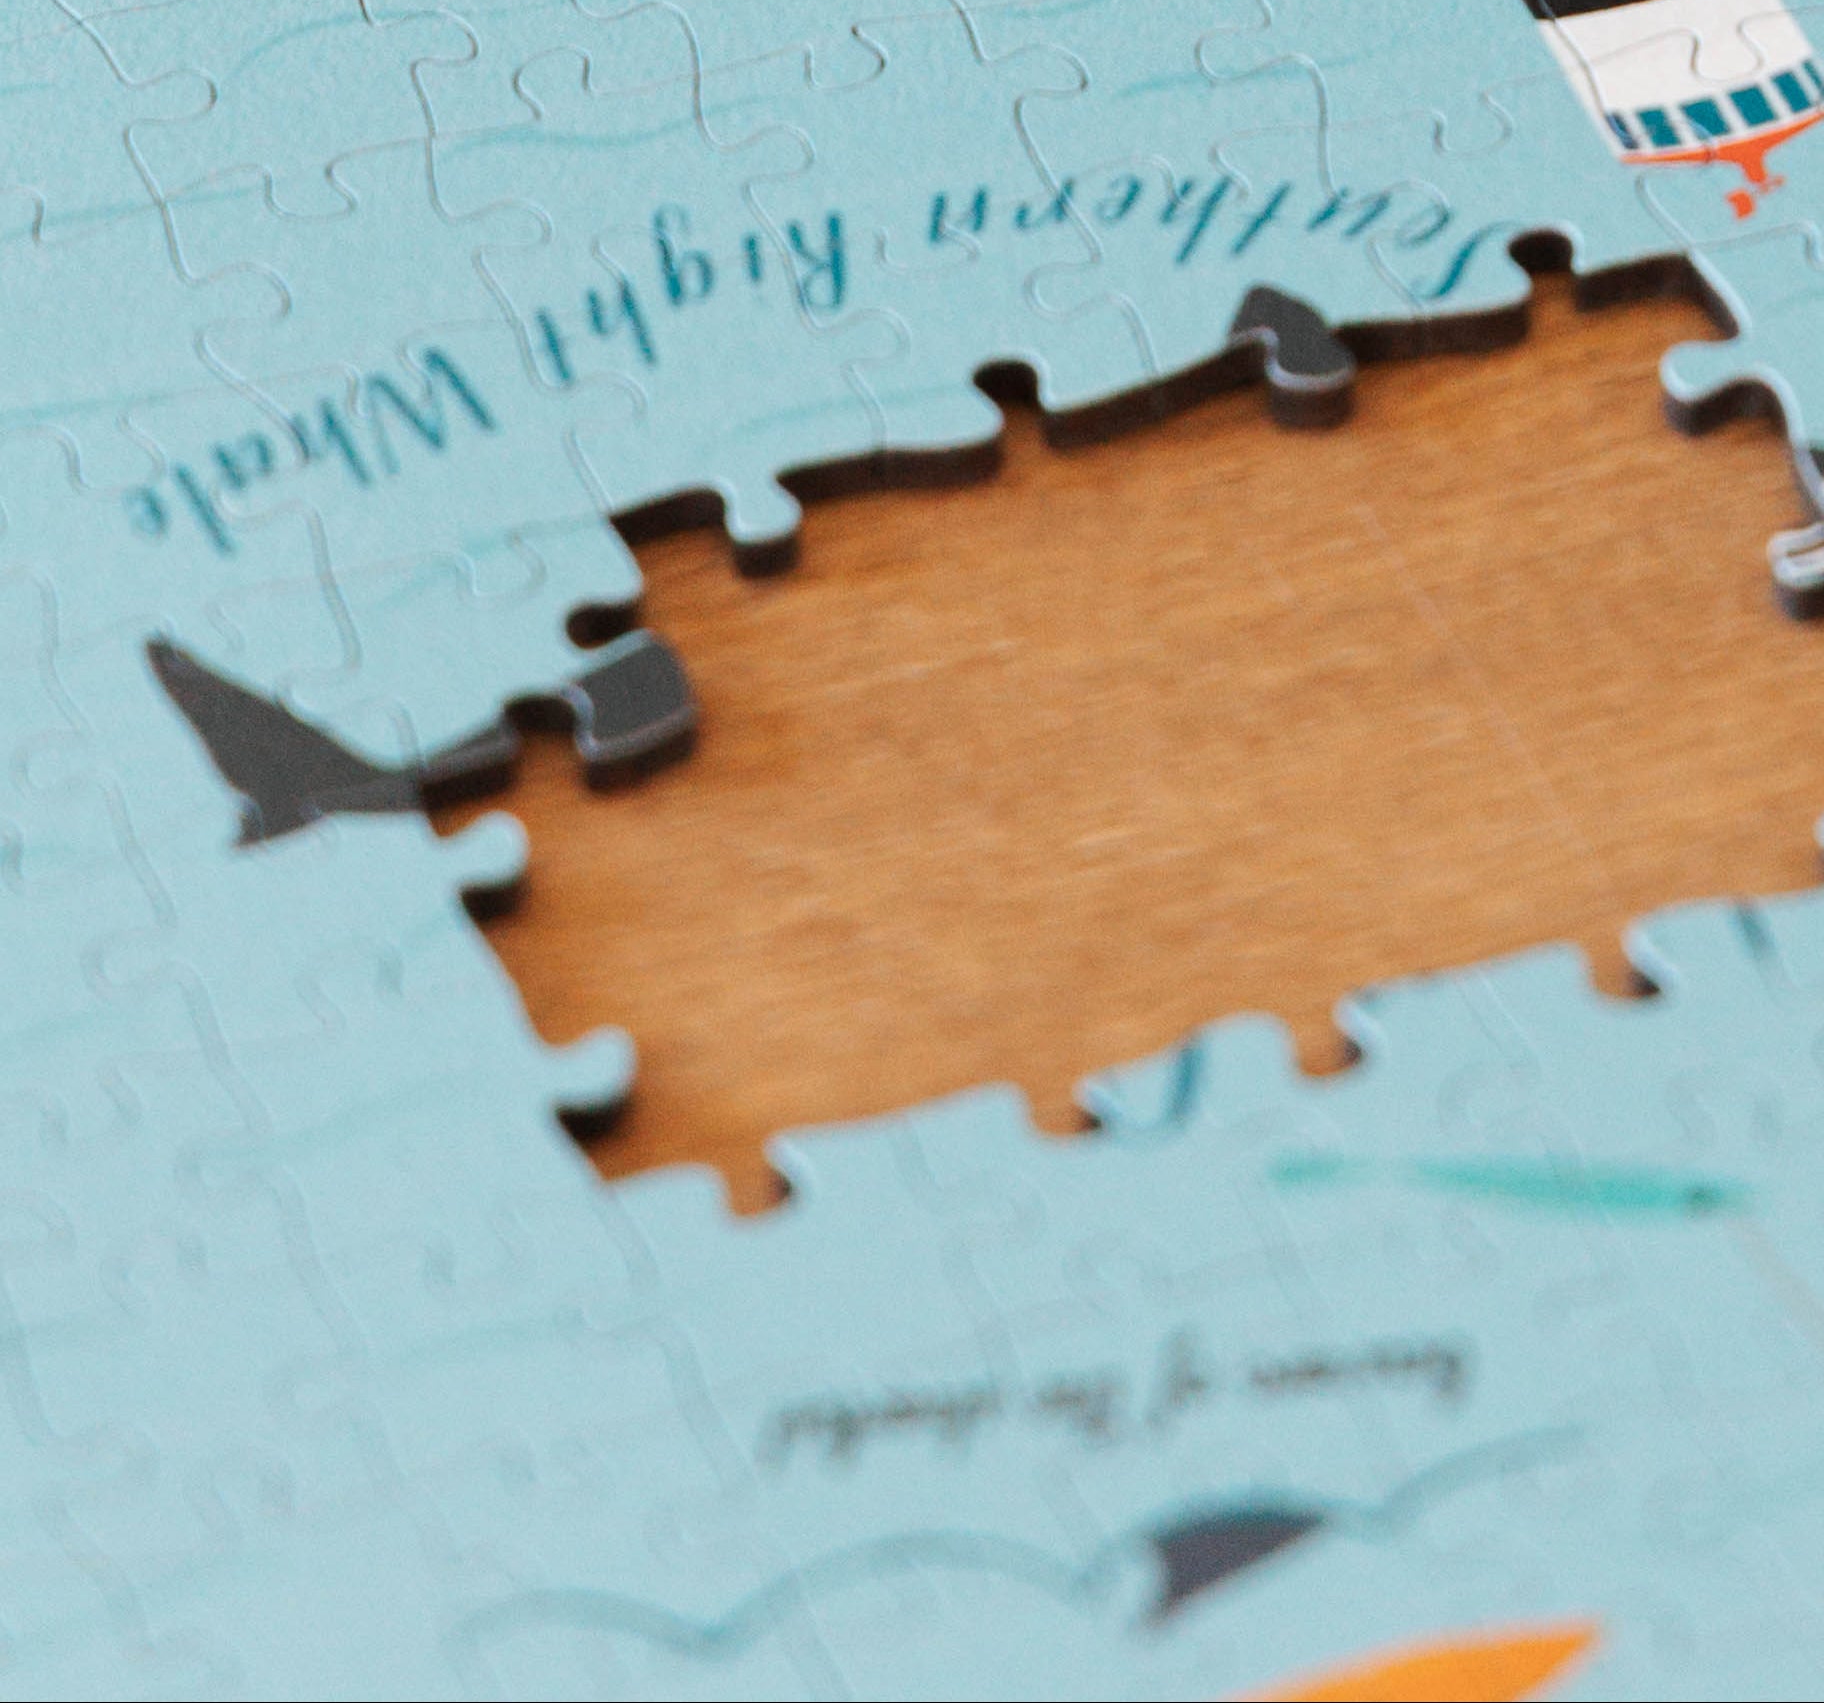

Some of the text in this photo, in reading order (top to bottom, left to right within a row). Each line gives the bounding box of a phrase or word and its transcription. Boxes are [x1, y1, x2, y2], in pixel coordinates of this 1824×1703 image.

[125, 175, 1514, 559] Southern Right Whale
